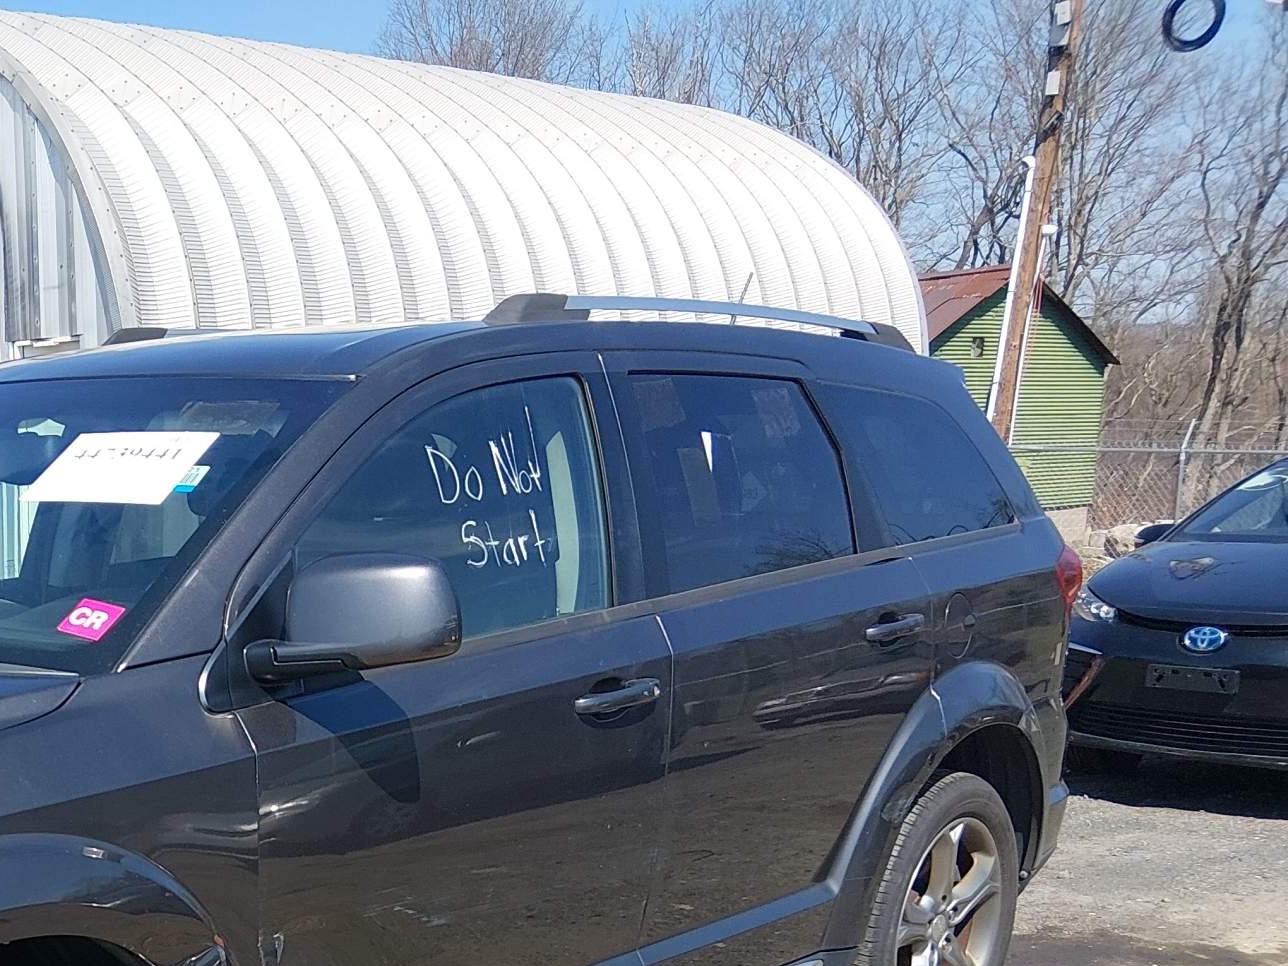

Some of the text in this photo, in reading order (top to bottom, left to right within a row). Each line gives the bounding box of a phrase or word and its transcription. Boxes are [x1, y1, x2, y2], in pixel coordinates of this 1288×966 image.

[424, 405, 542, 504] Do Not
[460, 509, 547, 567] Start
[68, 606, 109, 631] CR
